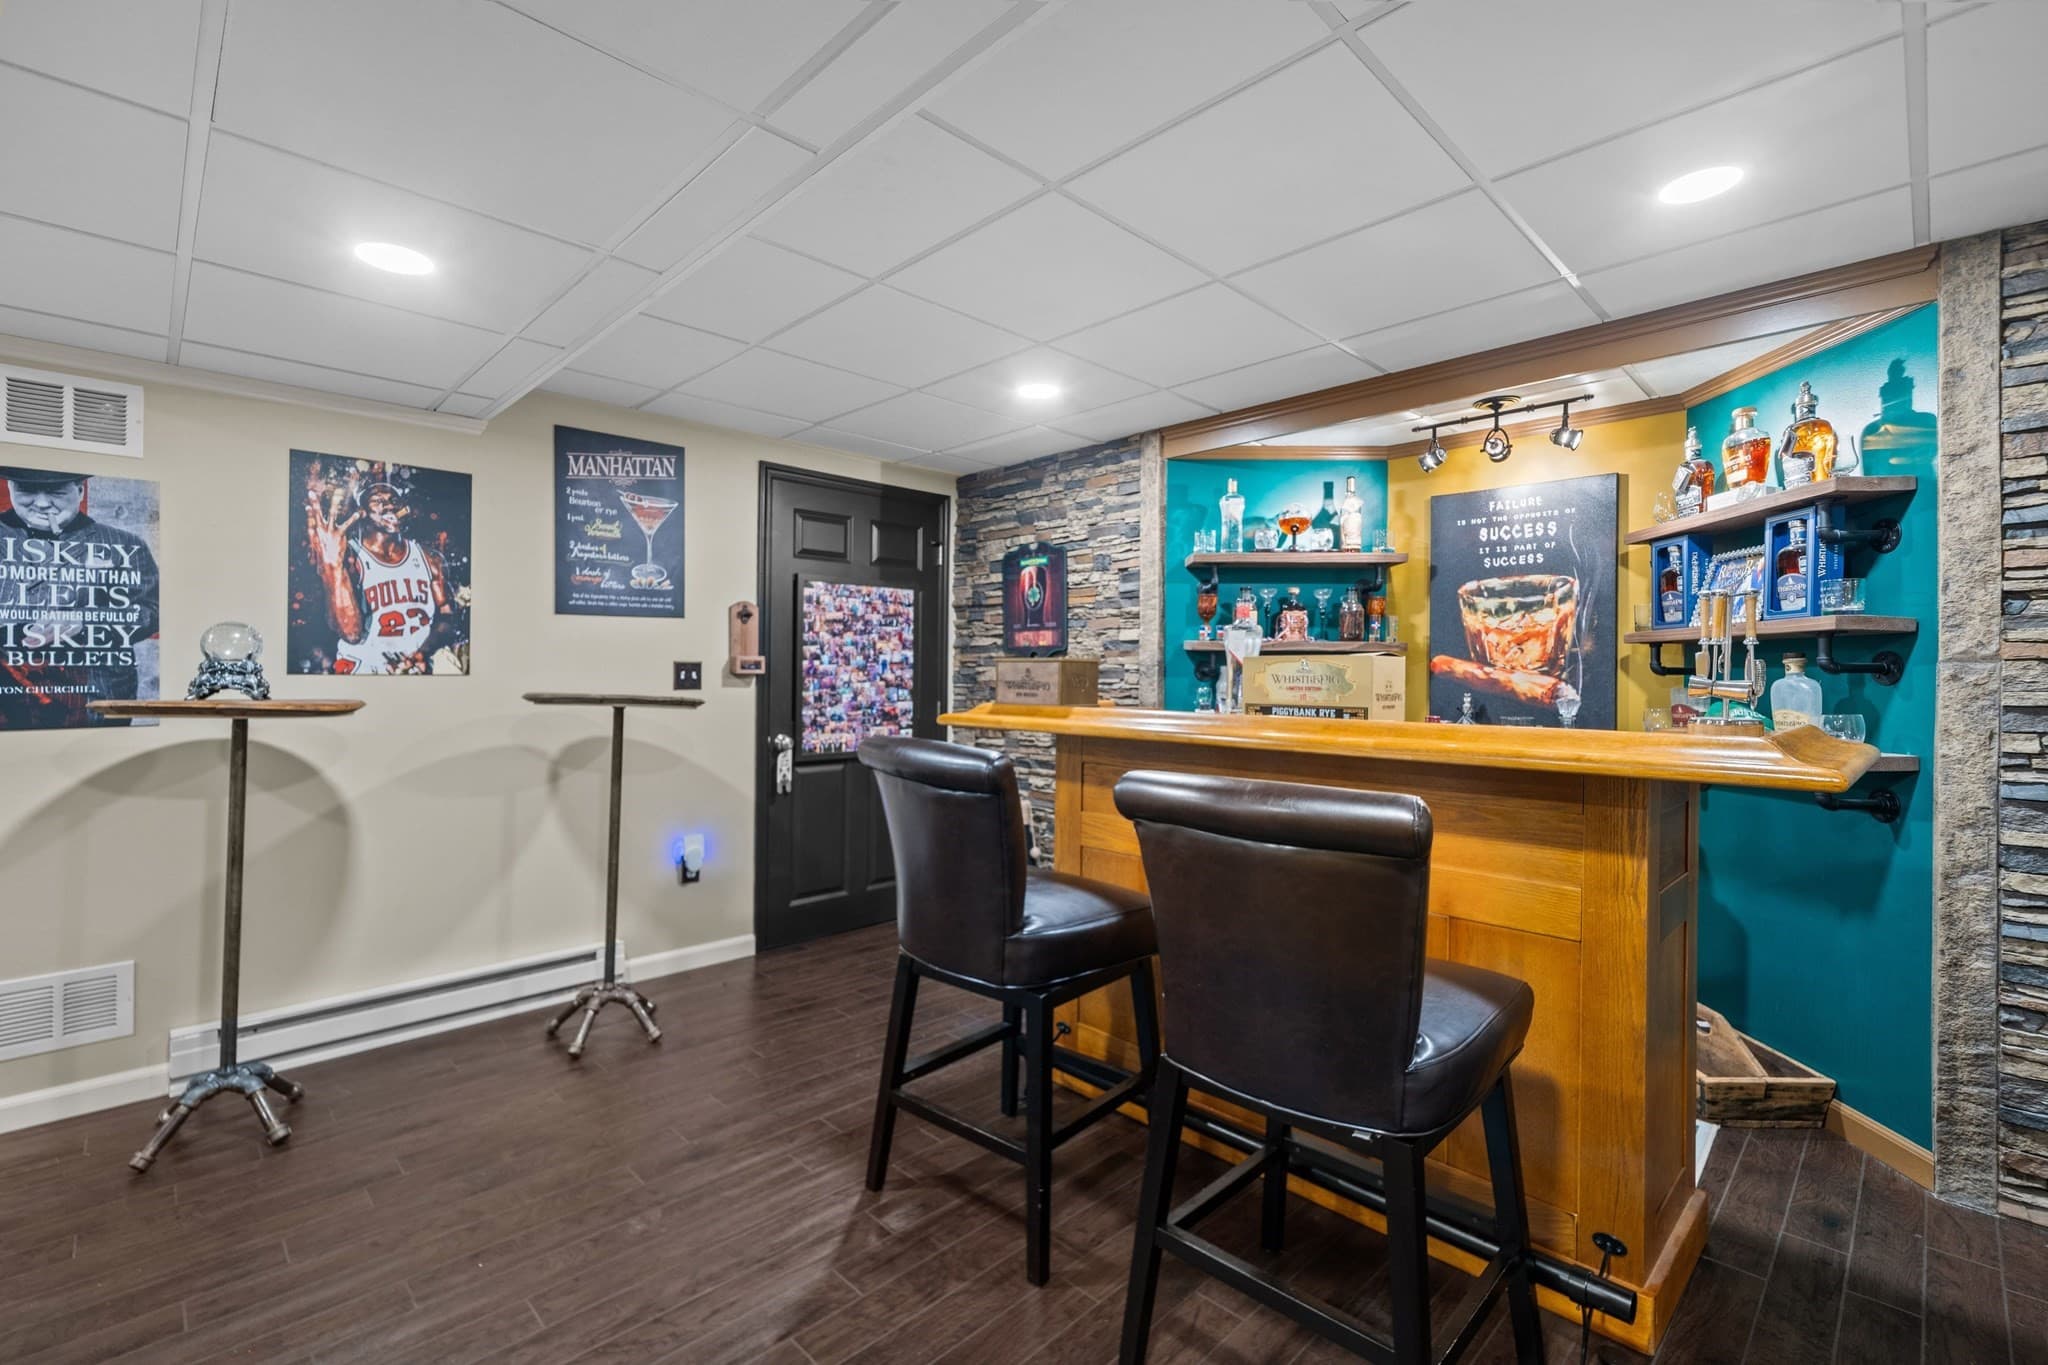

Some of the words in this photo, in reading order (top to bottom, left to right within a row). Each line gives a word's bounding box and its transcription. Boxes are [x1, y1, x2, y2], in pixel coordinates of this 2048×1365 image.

[567, 455, 676, 477] MANHATTAN
[1489, 496, 1543, 512] FAILURE
[1513, 510, 1560, 520] OPPOSITE
[1479, 521, 1557, 542] SUCCESS
[2, 537, 141, 568] ISKEY
[1514, 543, 1537, 551] PART
[1545, 541, 1556, 549] OF
[1484, 553, 1544, 568] SUCCESS
[10, 565, 58, 581] MORE
[61, 568, 96, 583] MEN
[99, 570, 141, 585] THAN
[364, 578, 429, 612] BULLS
[0, 609, 40, 620] WOULD
[41, 610, 83, 621] RATHER
[85, 611, 99, 622] BE
[100, 611, 125, 622] FULL
[126, 612, 140, 623] OF
[378, 608, 431, 637] 23
[2, 623, 141, 648] ISKEY
[7, 651, 139, 666] BULLETS.
[1272, 706, 1317, 717] PIGGYBANK
[1319, 708, 1336, 718] RYE
